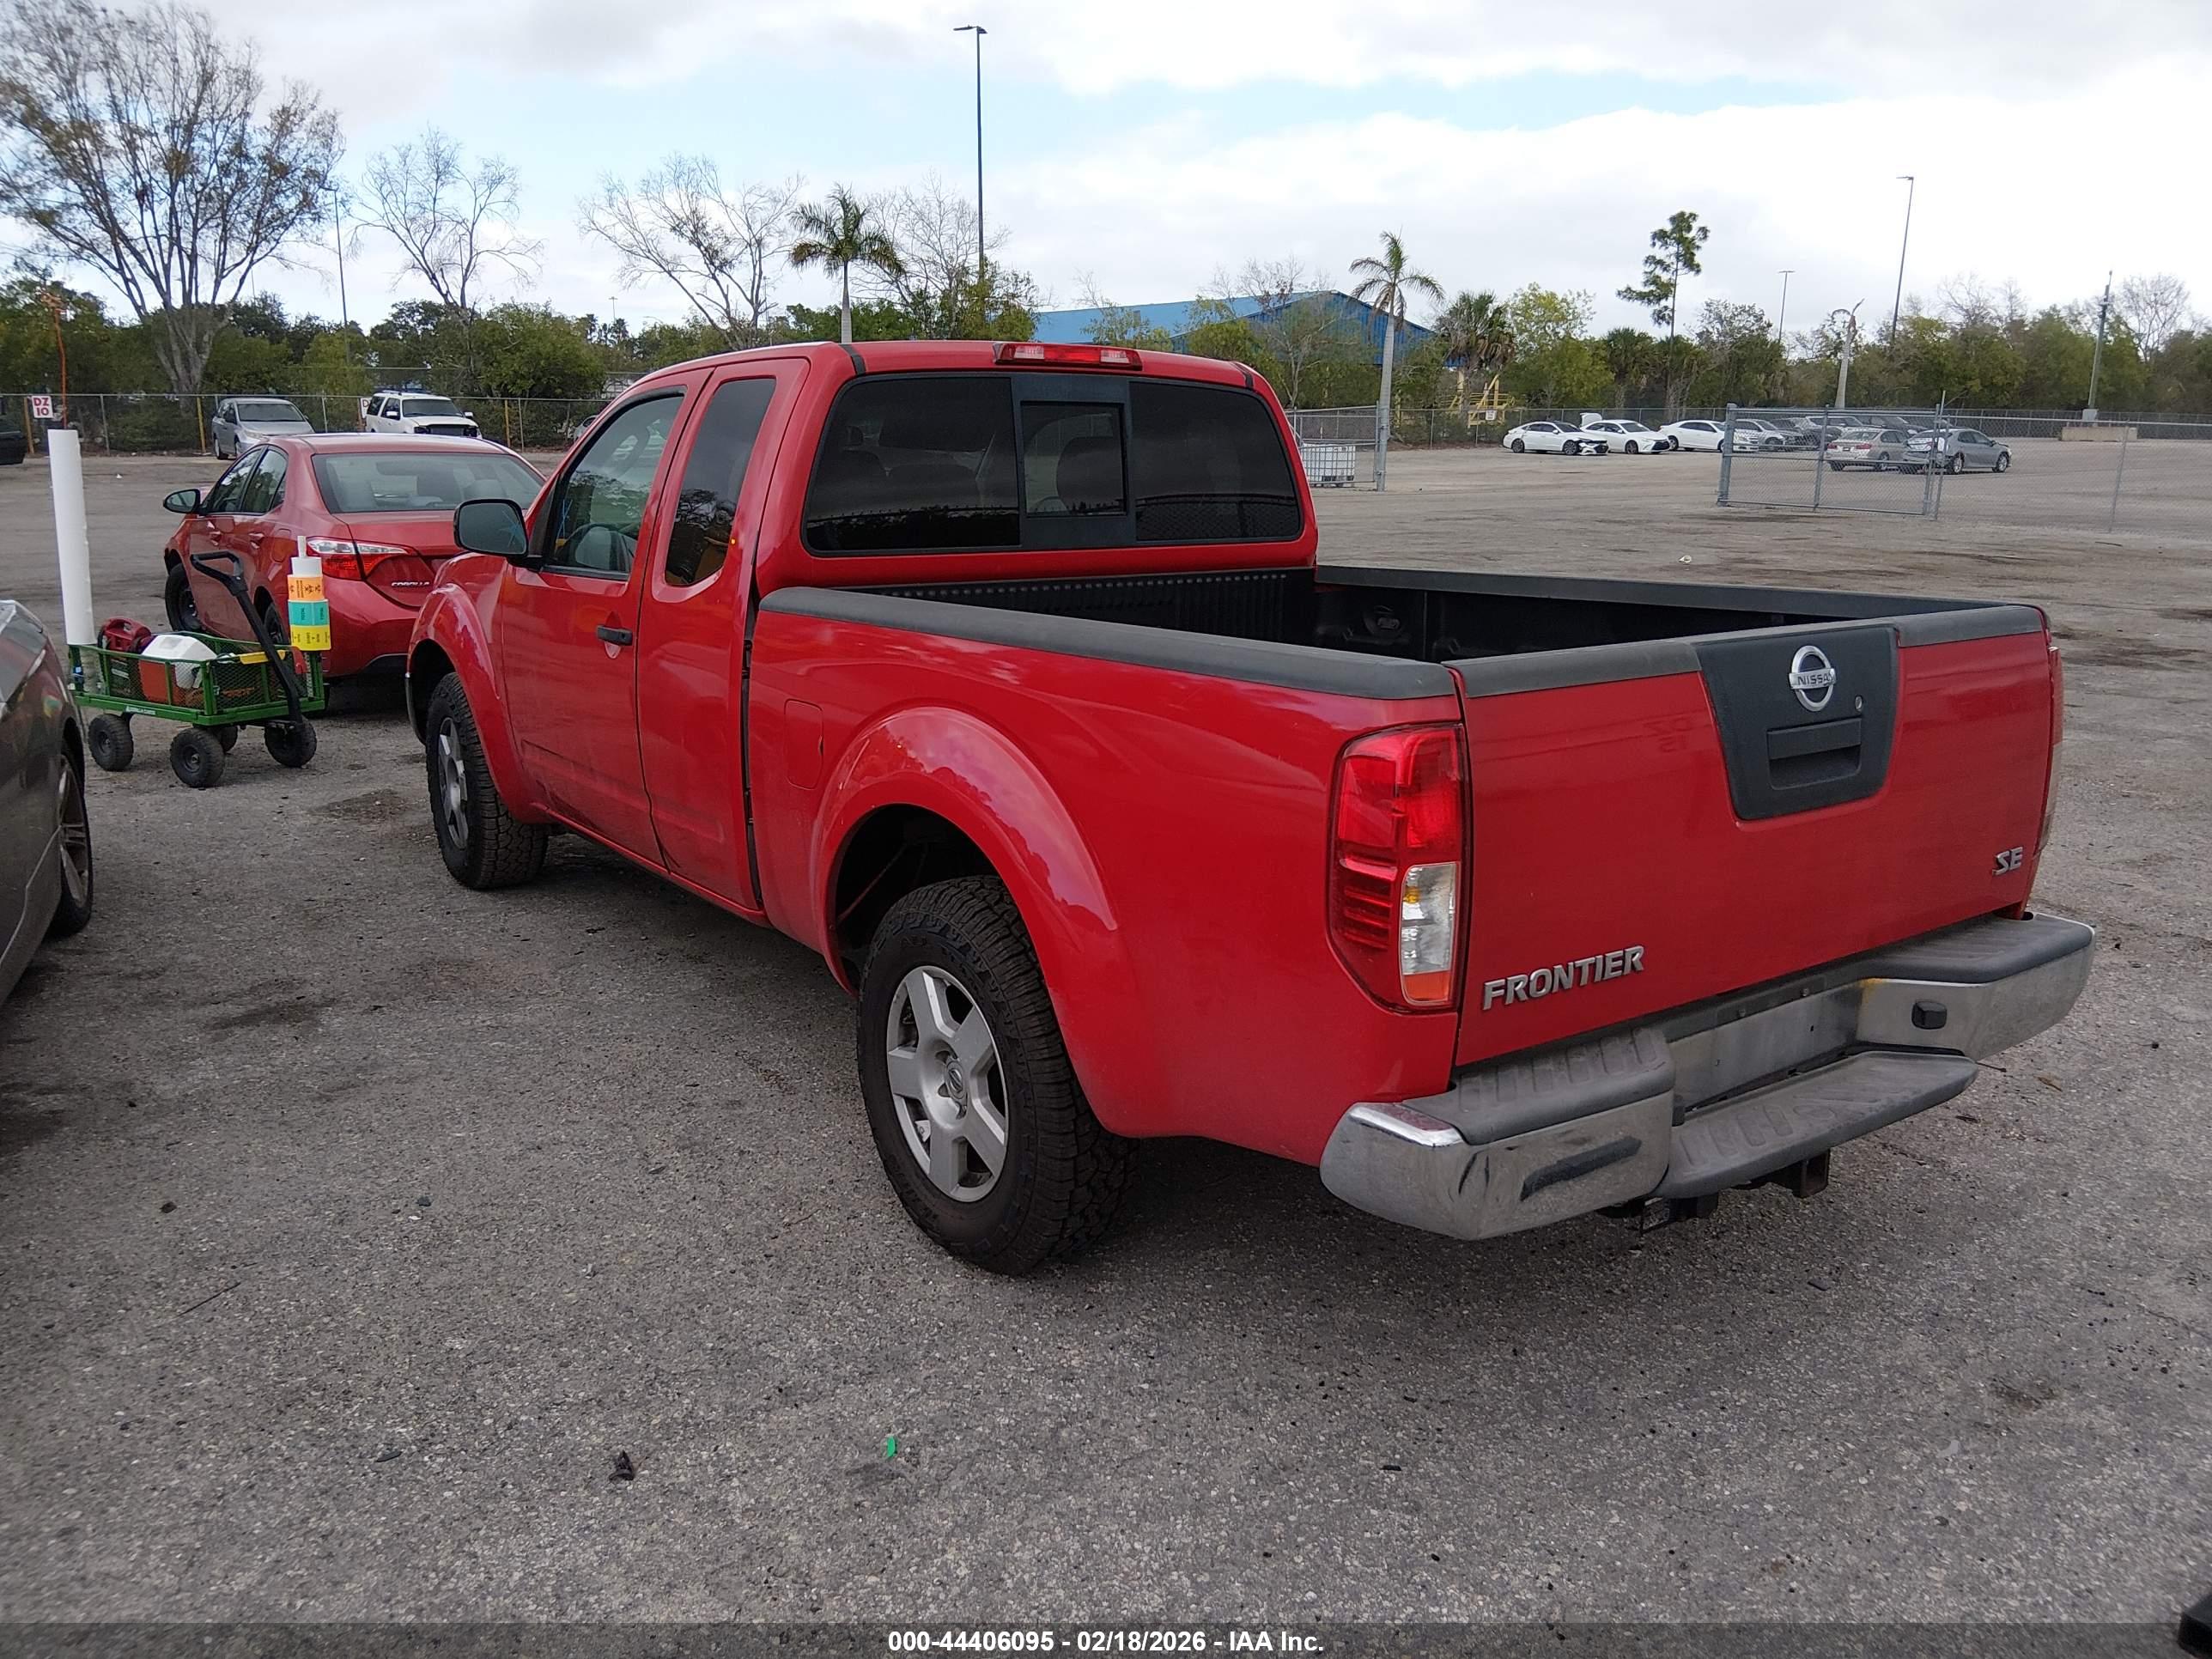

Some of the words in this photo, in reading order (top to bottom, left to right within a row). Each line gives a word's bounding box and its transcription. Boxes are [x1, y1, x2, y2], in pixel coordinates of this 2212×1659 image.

[33, 398, 49, 406] DZ
[1992, 846, 2023, 875] SE
[1482, 945, 1644, 1011] FRONTIER
